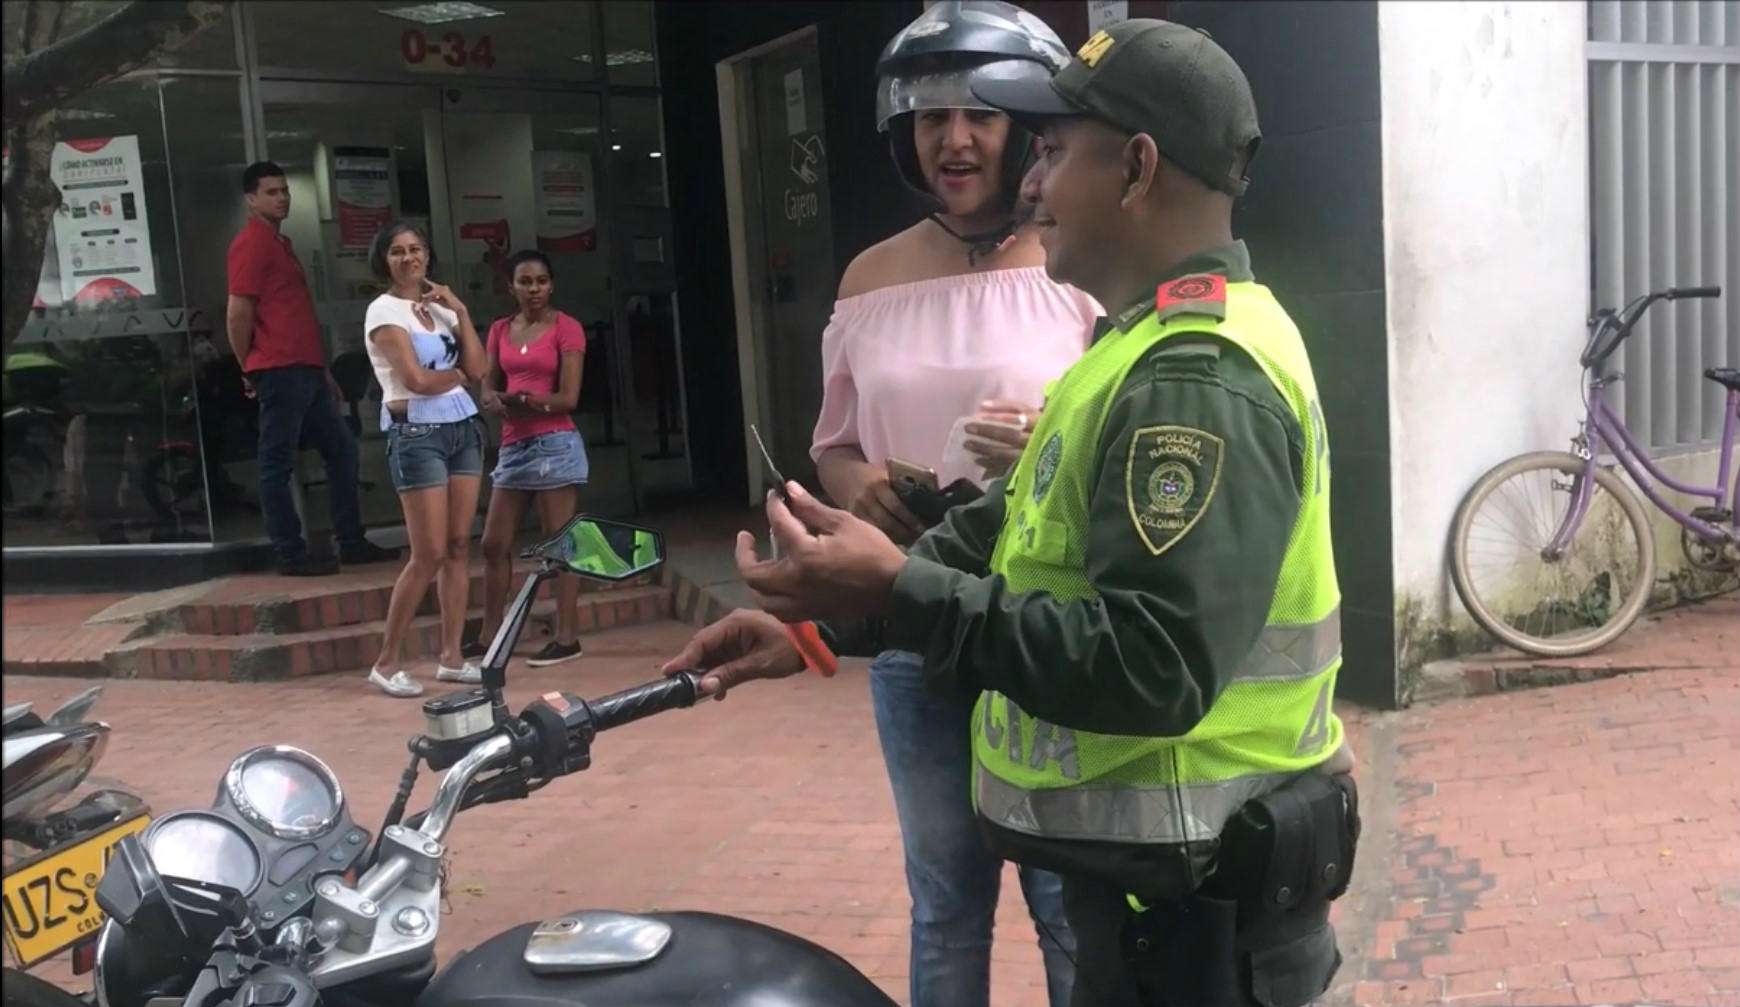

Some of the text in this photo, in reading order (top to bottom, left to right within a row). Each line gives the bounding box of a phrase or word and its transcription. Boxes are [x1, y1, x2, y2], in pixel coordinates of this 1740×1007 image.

[401, 29, 496, 68] 0-34
[785, 188, 818, 226] Cajero
[1148, 443, 1204, 466] NACIONAL
